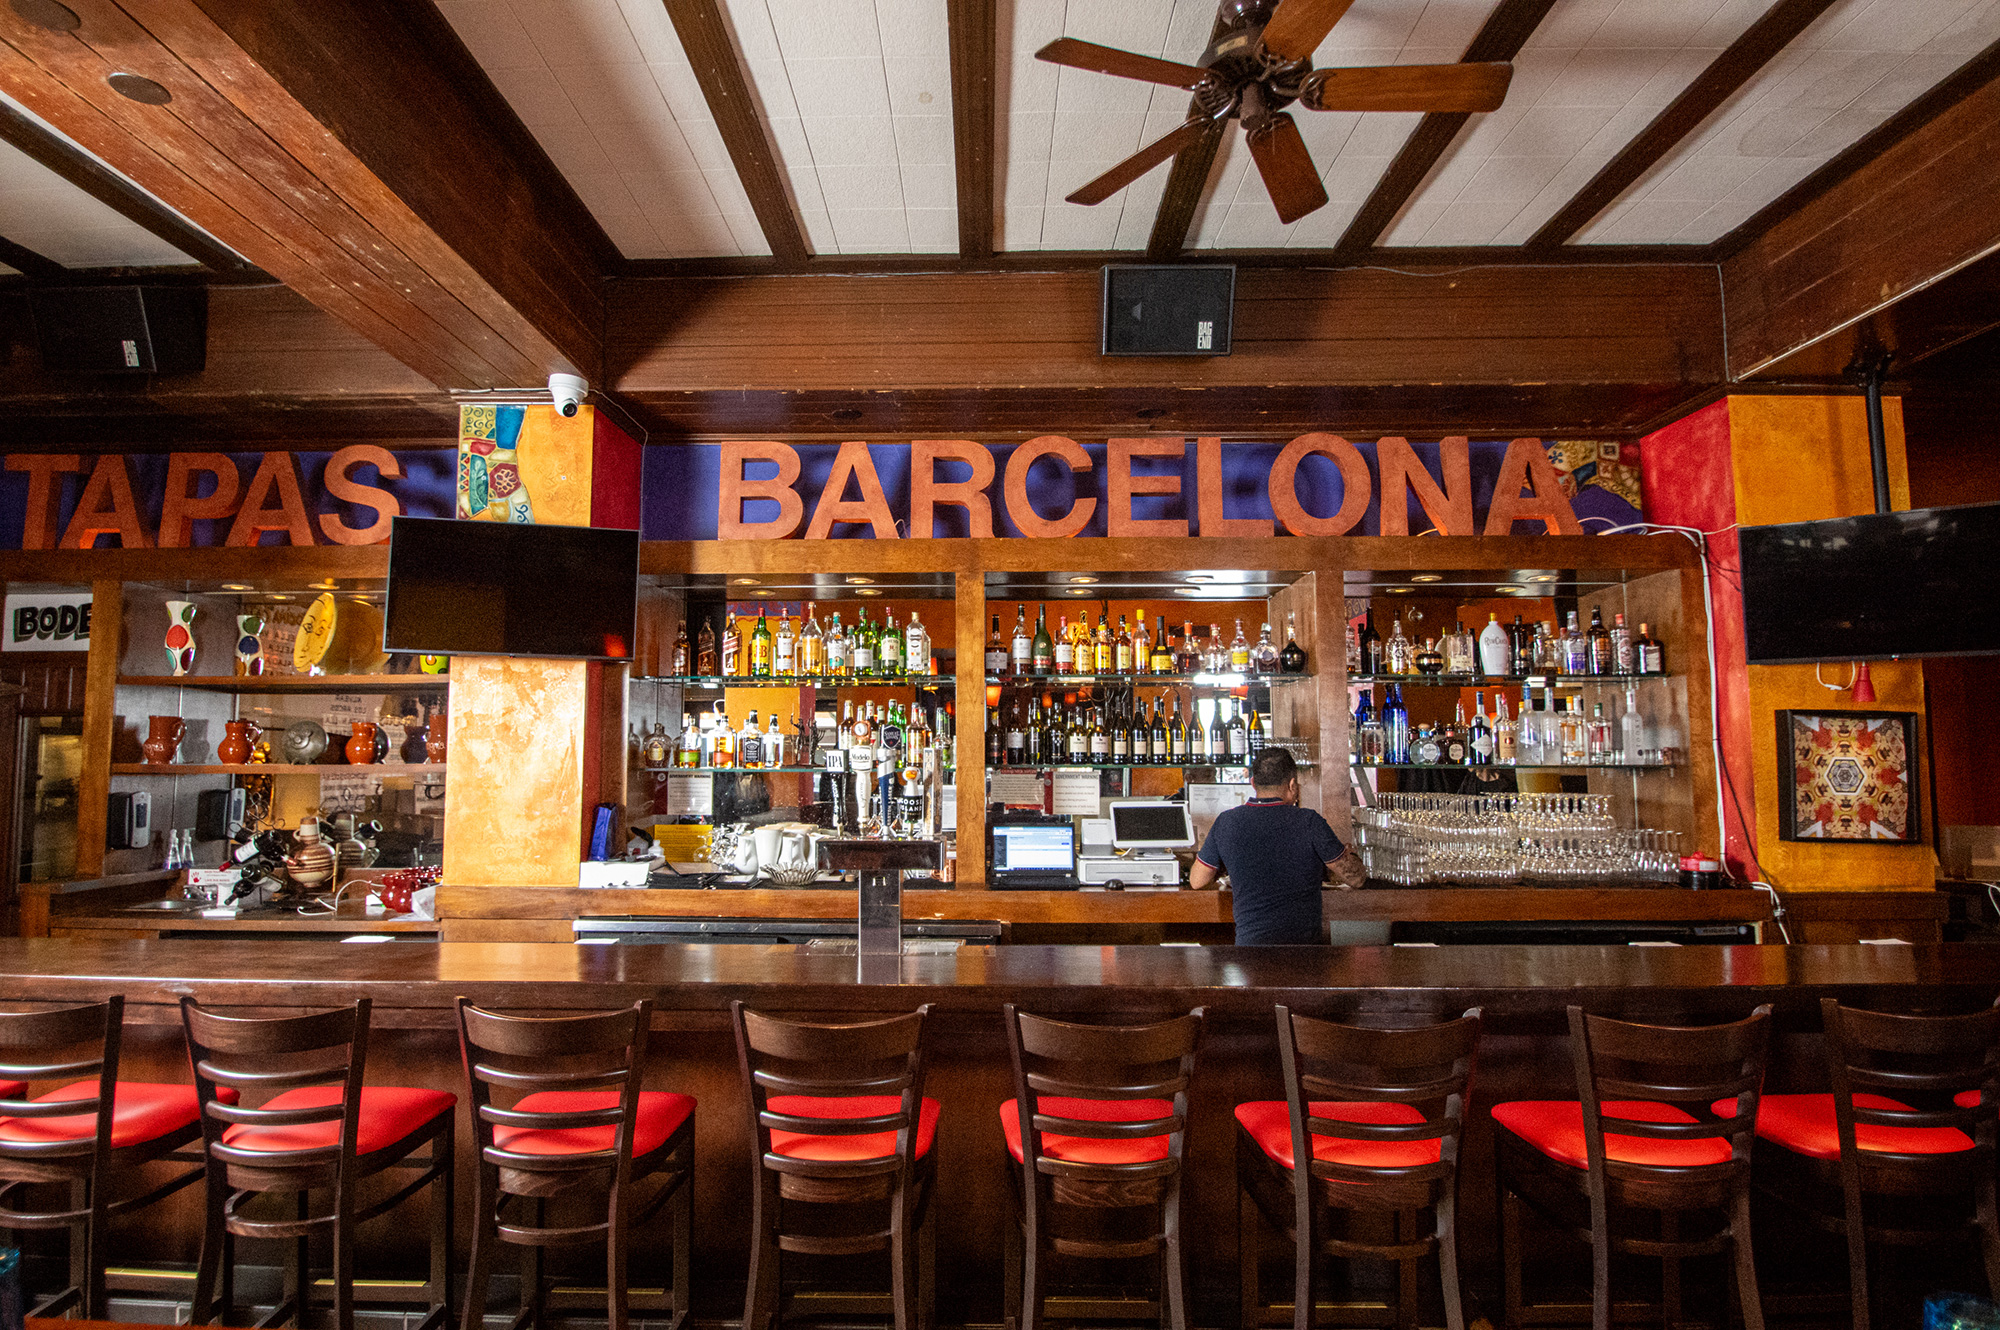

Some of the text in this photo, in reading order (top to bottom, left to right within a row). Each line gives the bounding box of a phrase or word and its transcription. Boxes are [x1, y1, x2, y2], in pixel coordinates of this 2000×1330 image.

[1199, 322, 1213, 335] BAG
[1197, 336, 1212, 349] END
[4, 444, 408, 549] TAPAS
[717, 432, 1585, 540] BARCELONA
[13, 603, 92, 643] BODE
[828, 755, 843, 768] IPA
